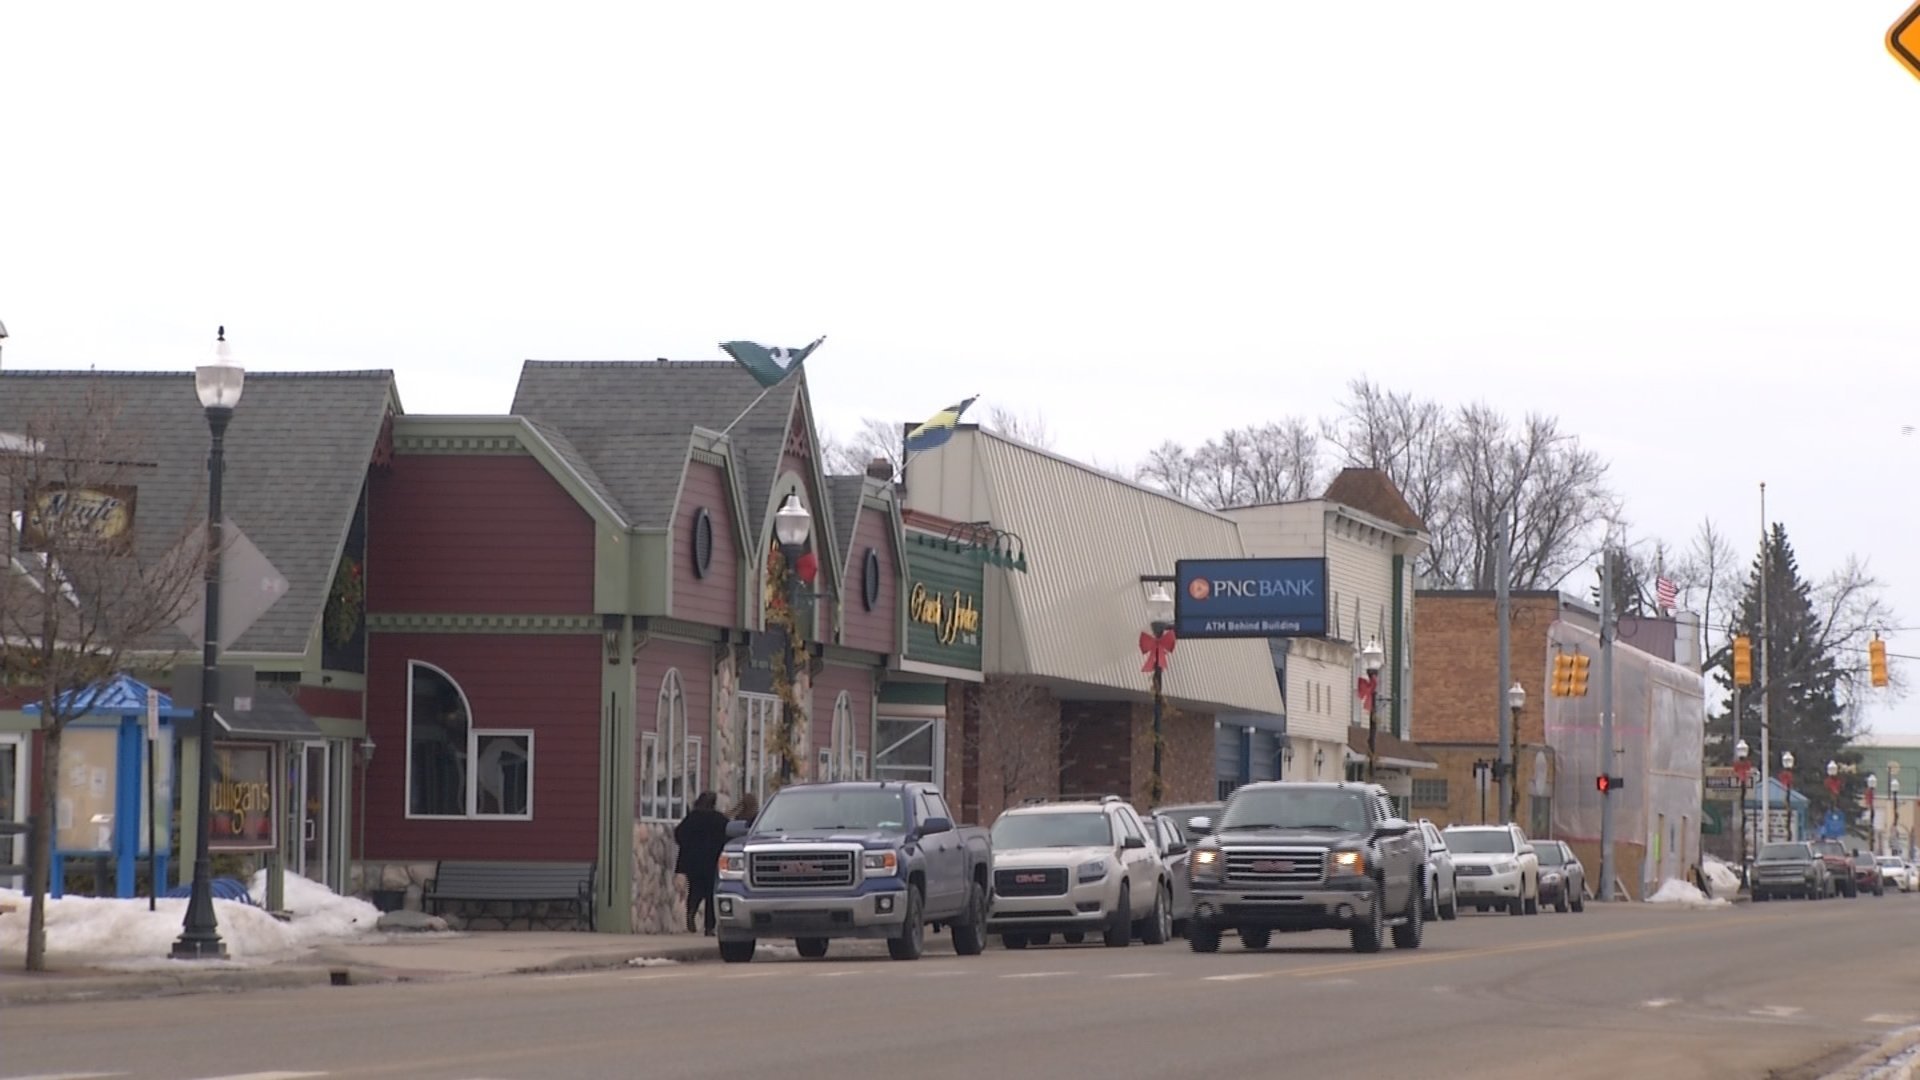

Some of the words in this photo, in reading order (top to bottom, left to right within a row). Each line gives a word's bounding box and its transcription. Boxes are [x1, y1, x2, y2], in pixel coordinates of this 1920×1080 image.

[1213, 579, 1256, 598] PNC
[1258, 579, 1315, 597] BANK
[1205, 621, 1226, 631] ATM
[1228, 620, 1260, 631] Behind
[1261, 620, 1300, 632] Building
[1015, 873, 1046, 884] GMC
